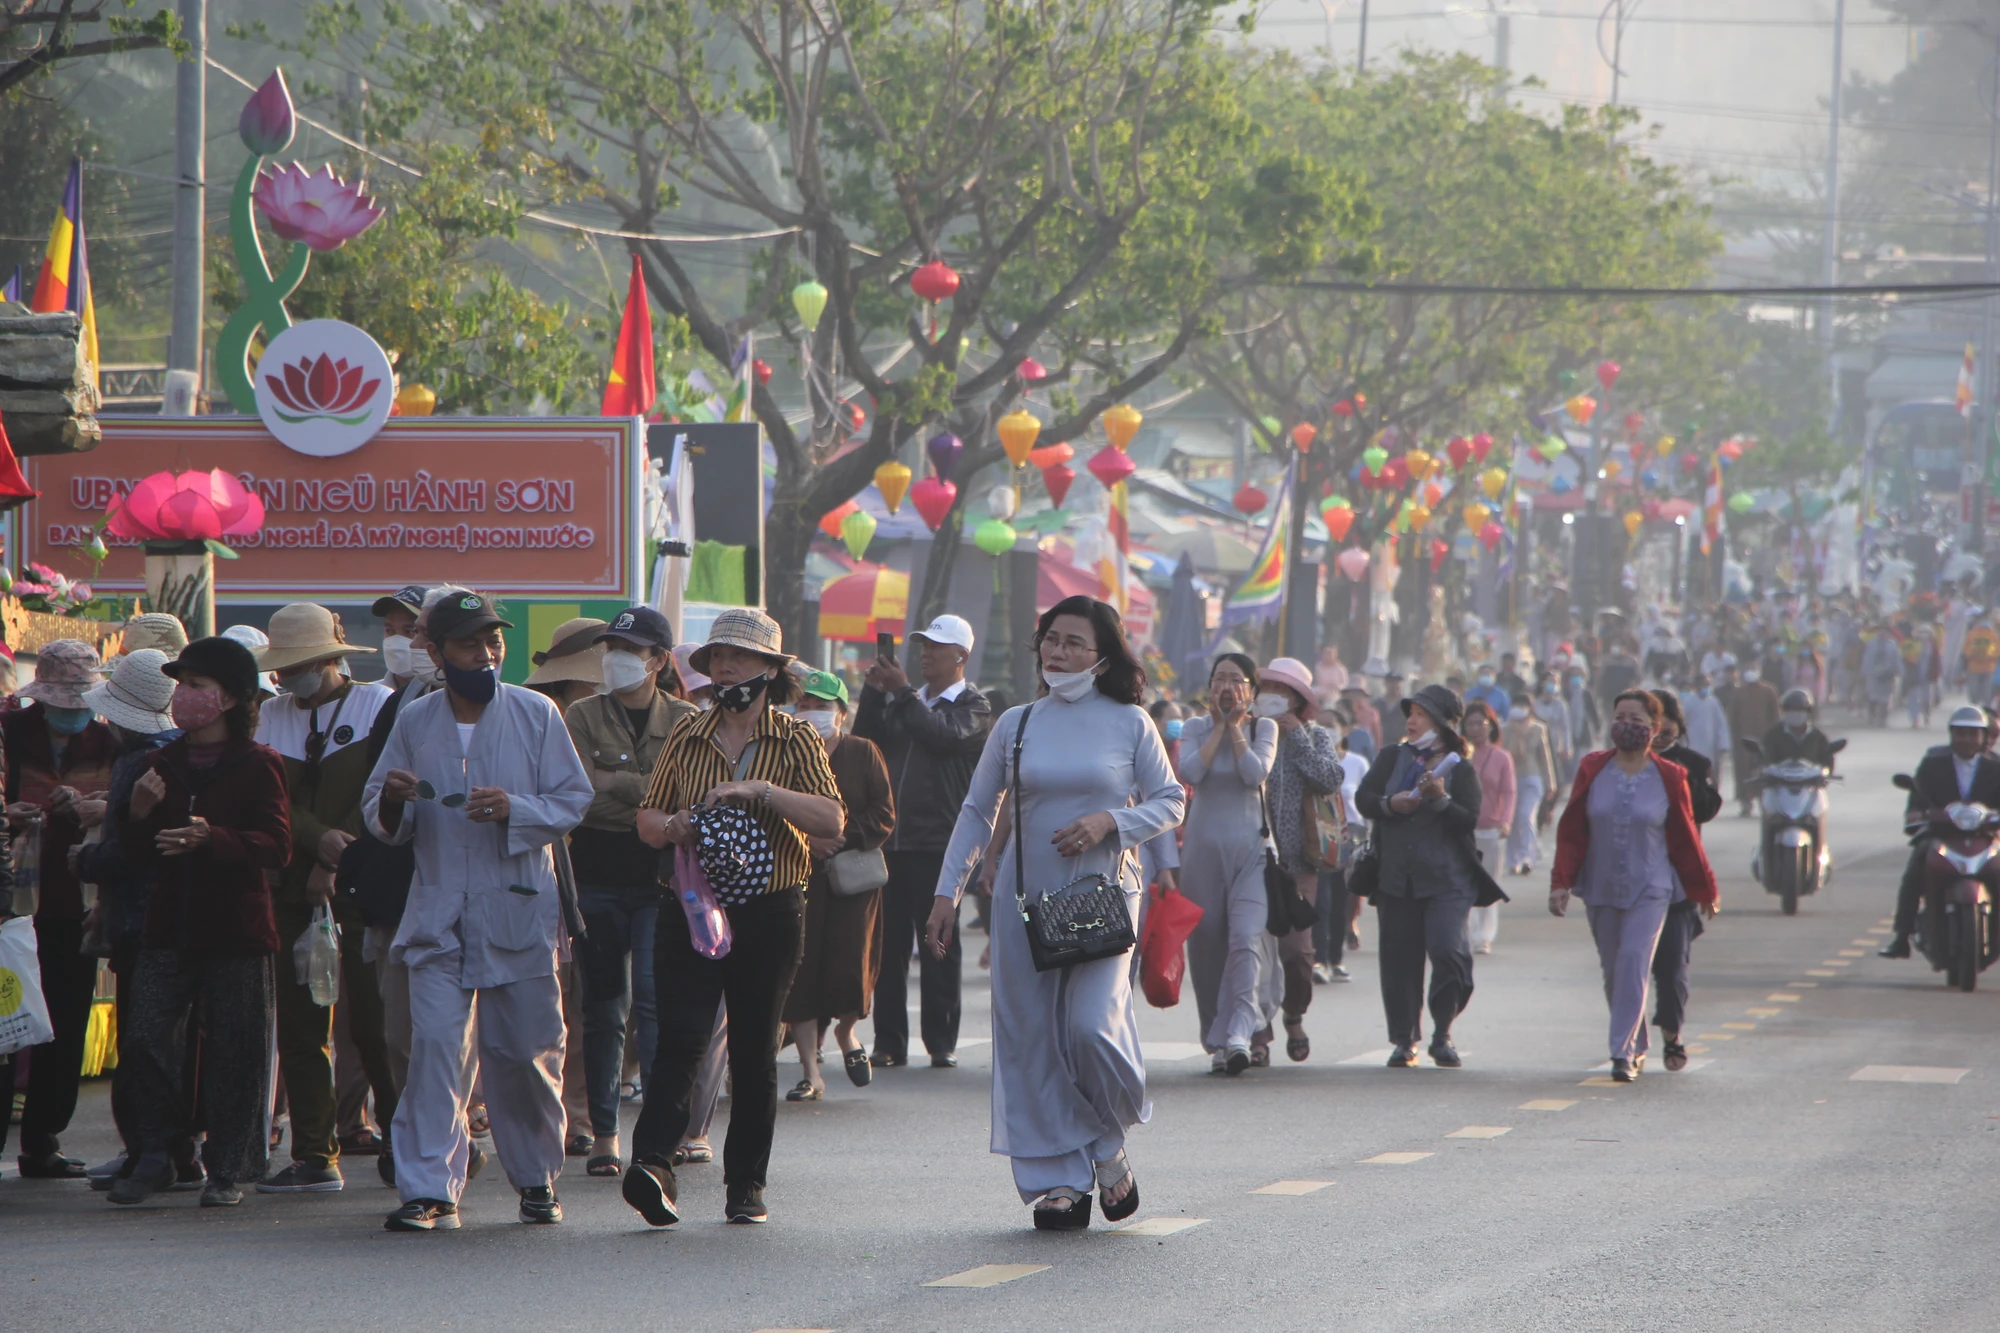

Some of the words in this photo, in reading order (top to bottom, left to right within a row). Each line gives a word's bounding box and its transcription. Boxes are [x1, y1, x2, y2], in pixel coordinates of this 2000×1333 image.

[71, 476, 142, 510] UBN
[293, 473, 375, 512] NGŨ
[384, 469, 485, 512] HÀNH
[495, 477, 574, 512] SƠN
[331, 522, 365, 548] ĐÁ
[405, 523, 469, 552] NGHỆ
[472, 527, 523, 548] NON
[526, 522, 595, 548] NƯỚC
